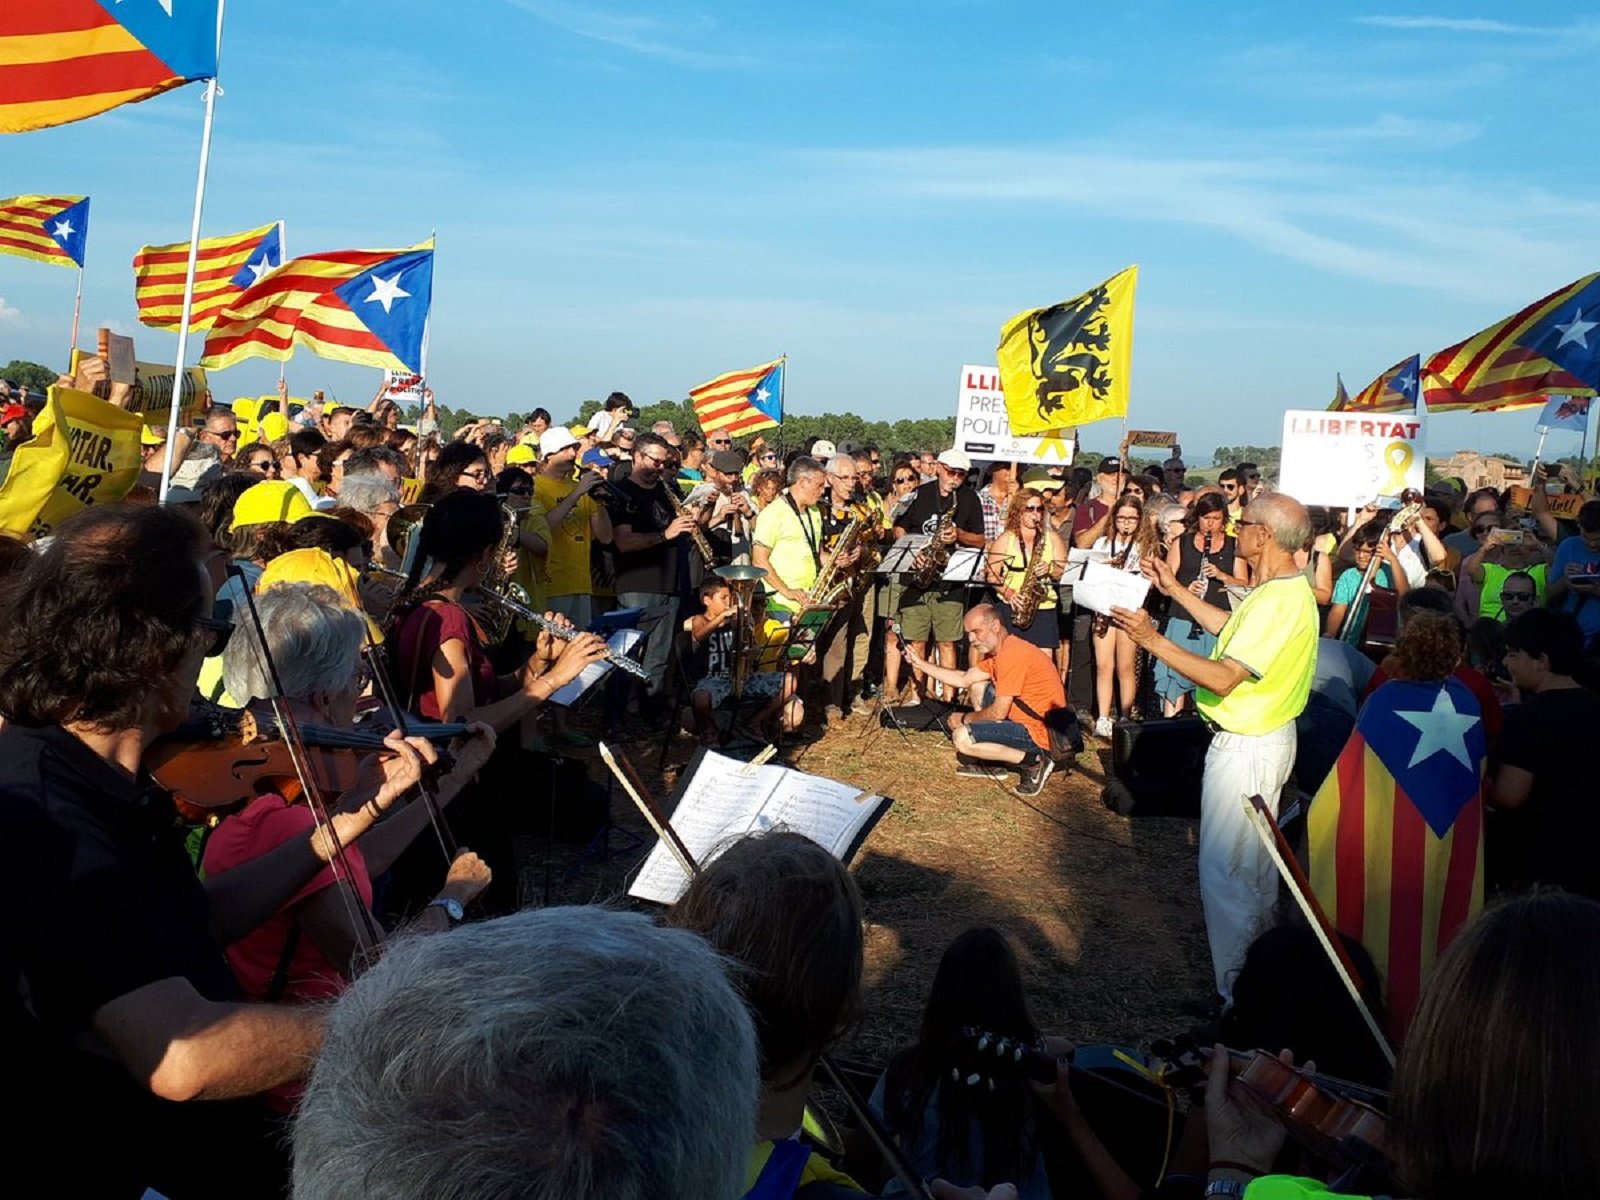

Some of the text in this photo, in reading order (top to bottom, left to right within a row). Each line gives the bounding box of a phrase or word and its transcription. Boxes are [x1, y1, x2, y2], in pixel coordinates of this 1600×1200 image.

[970, 395, 1008, 414] PRE
[1291, 417, 1421, 440] LLIBERTAT
[69, 427, 113, 473] OTAR.
